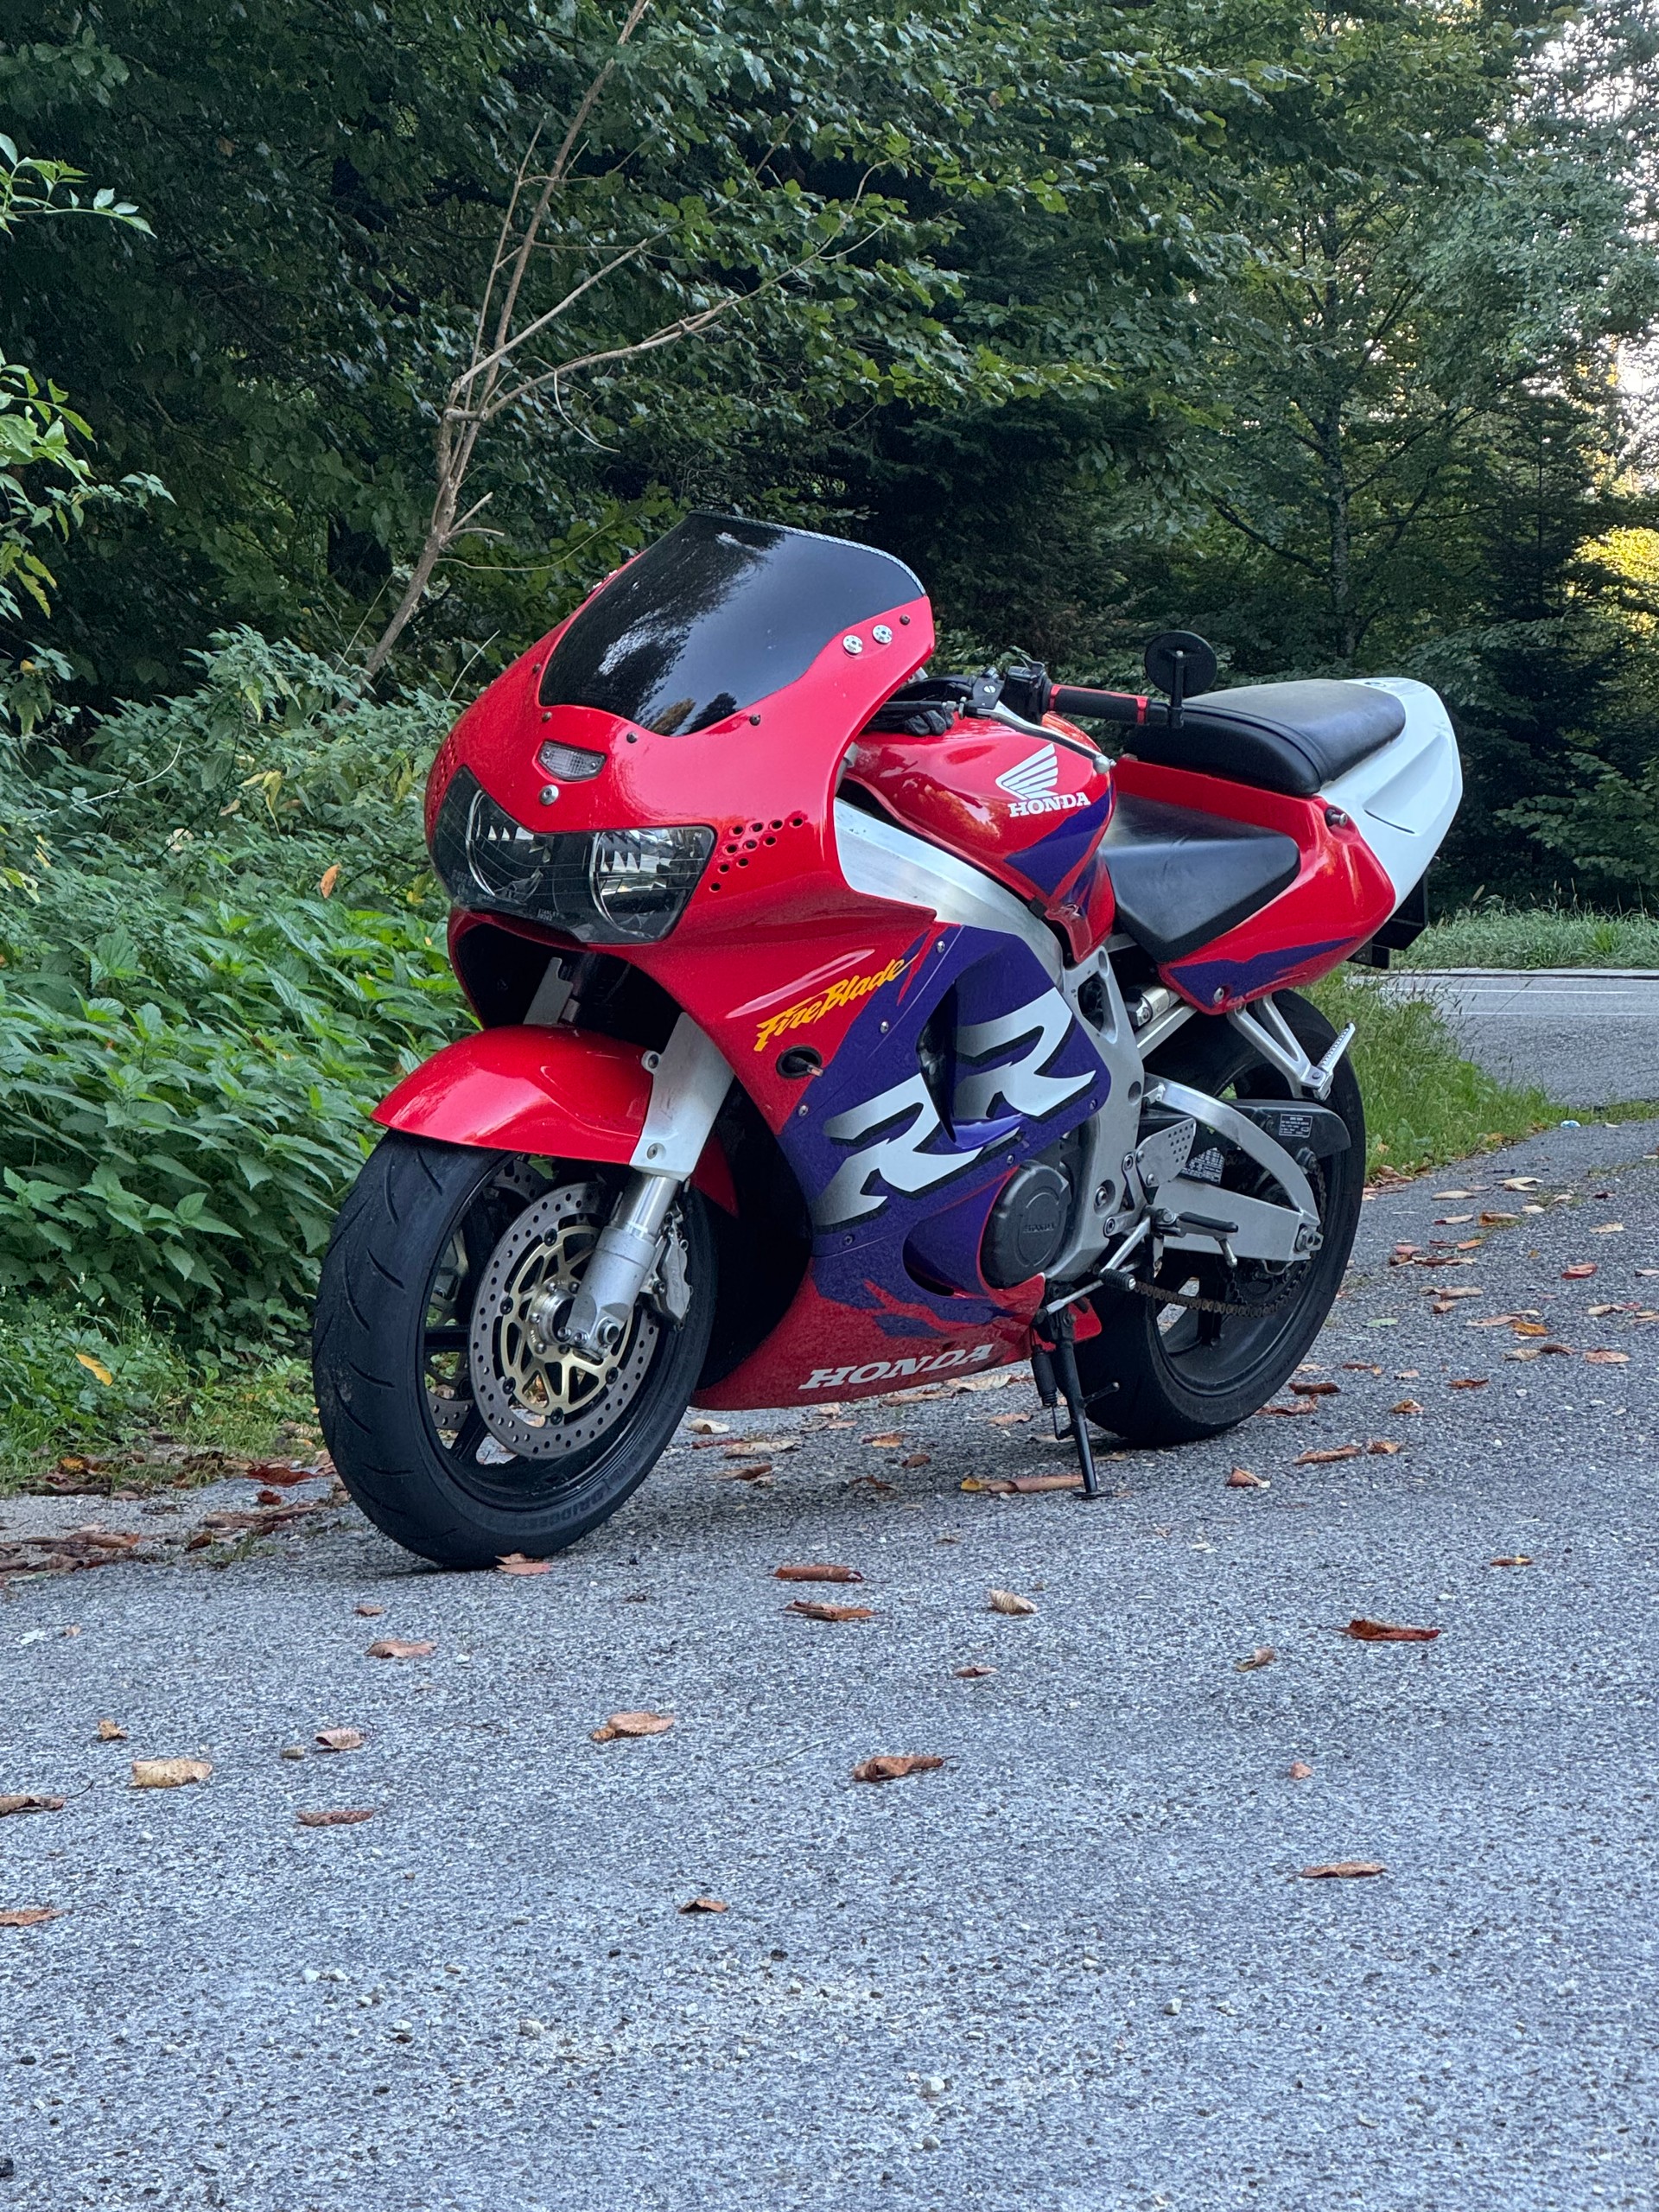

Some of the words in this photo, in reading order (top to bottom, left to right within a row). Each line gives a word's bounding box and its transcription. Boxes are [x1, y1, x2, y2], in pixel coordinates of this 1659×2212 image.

[1007, 791, 1091, 818] HONDA
[753, 953, 920, 1052] FireBlade
[810, 986, 1096, 1229] RR
[798, 1343, 995, 1389] HONDA
